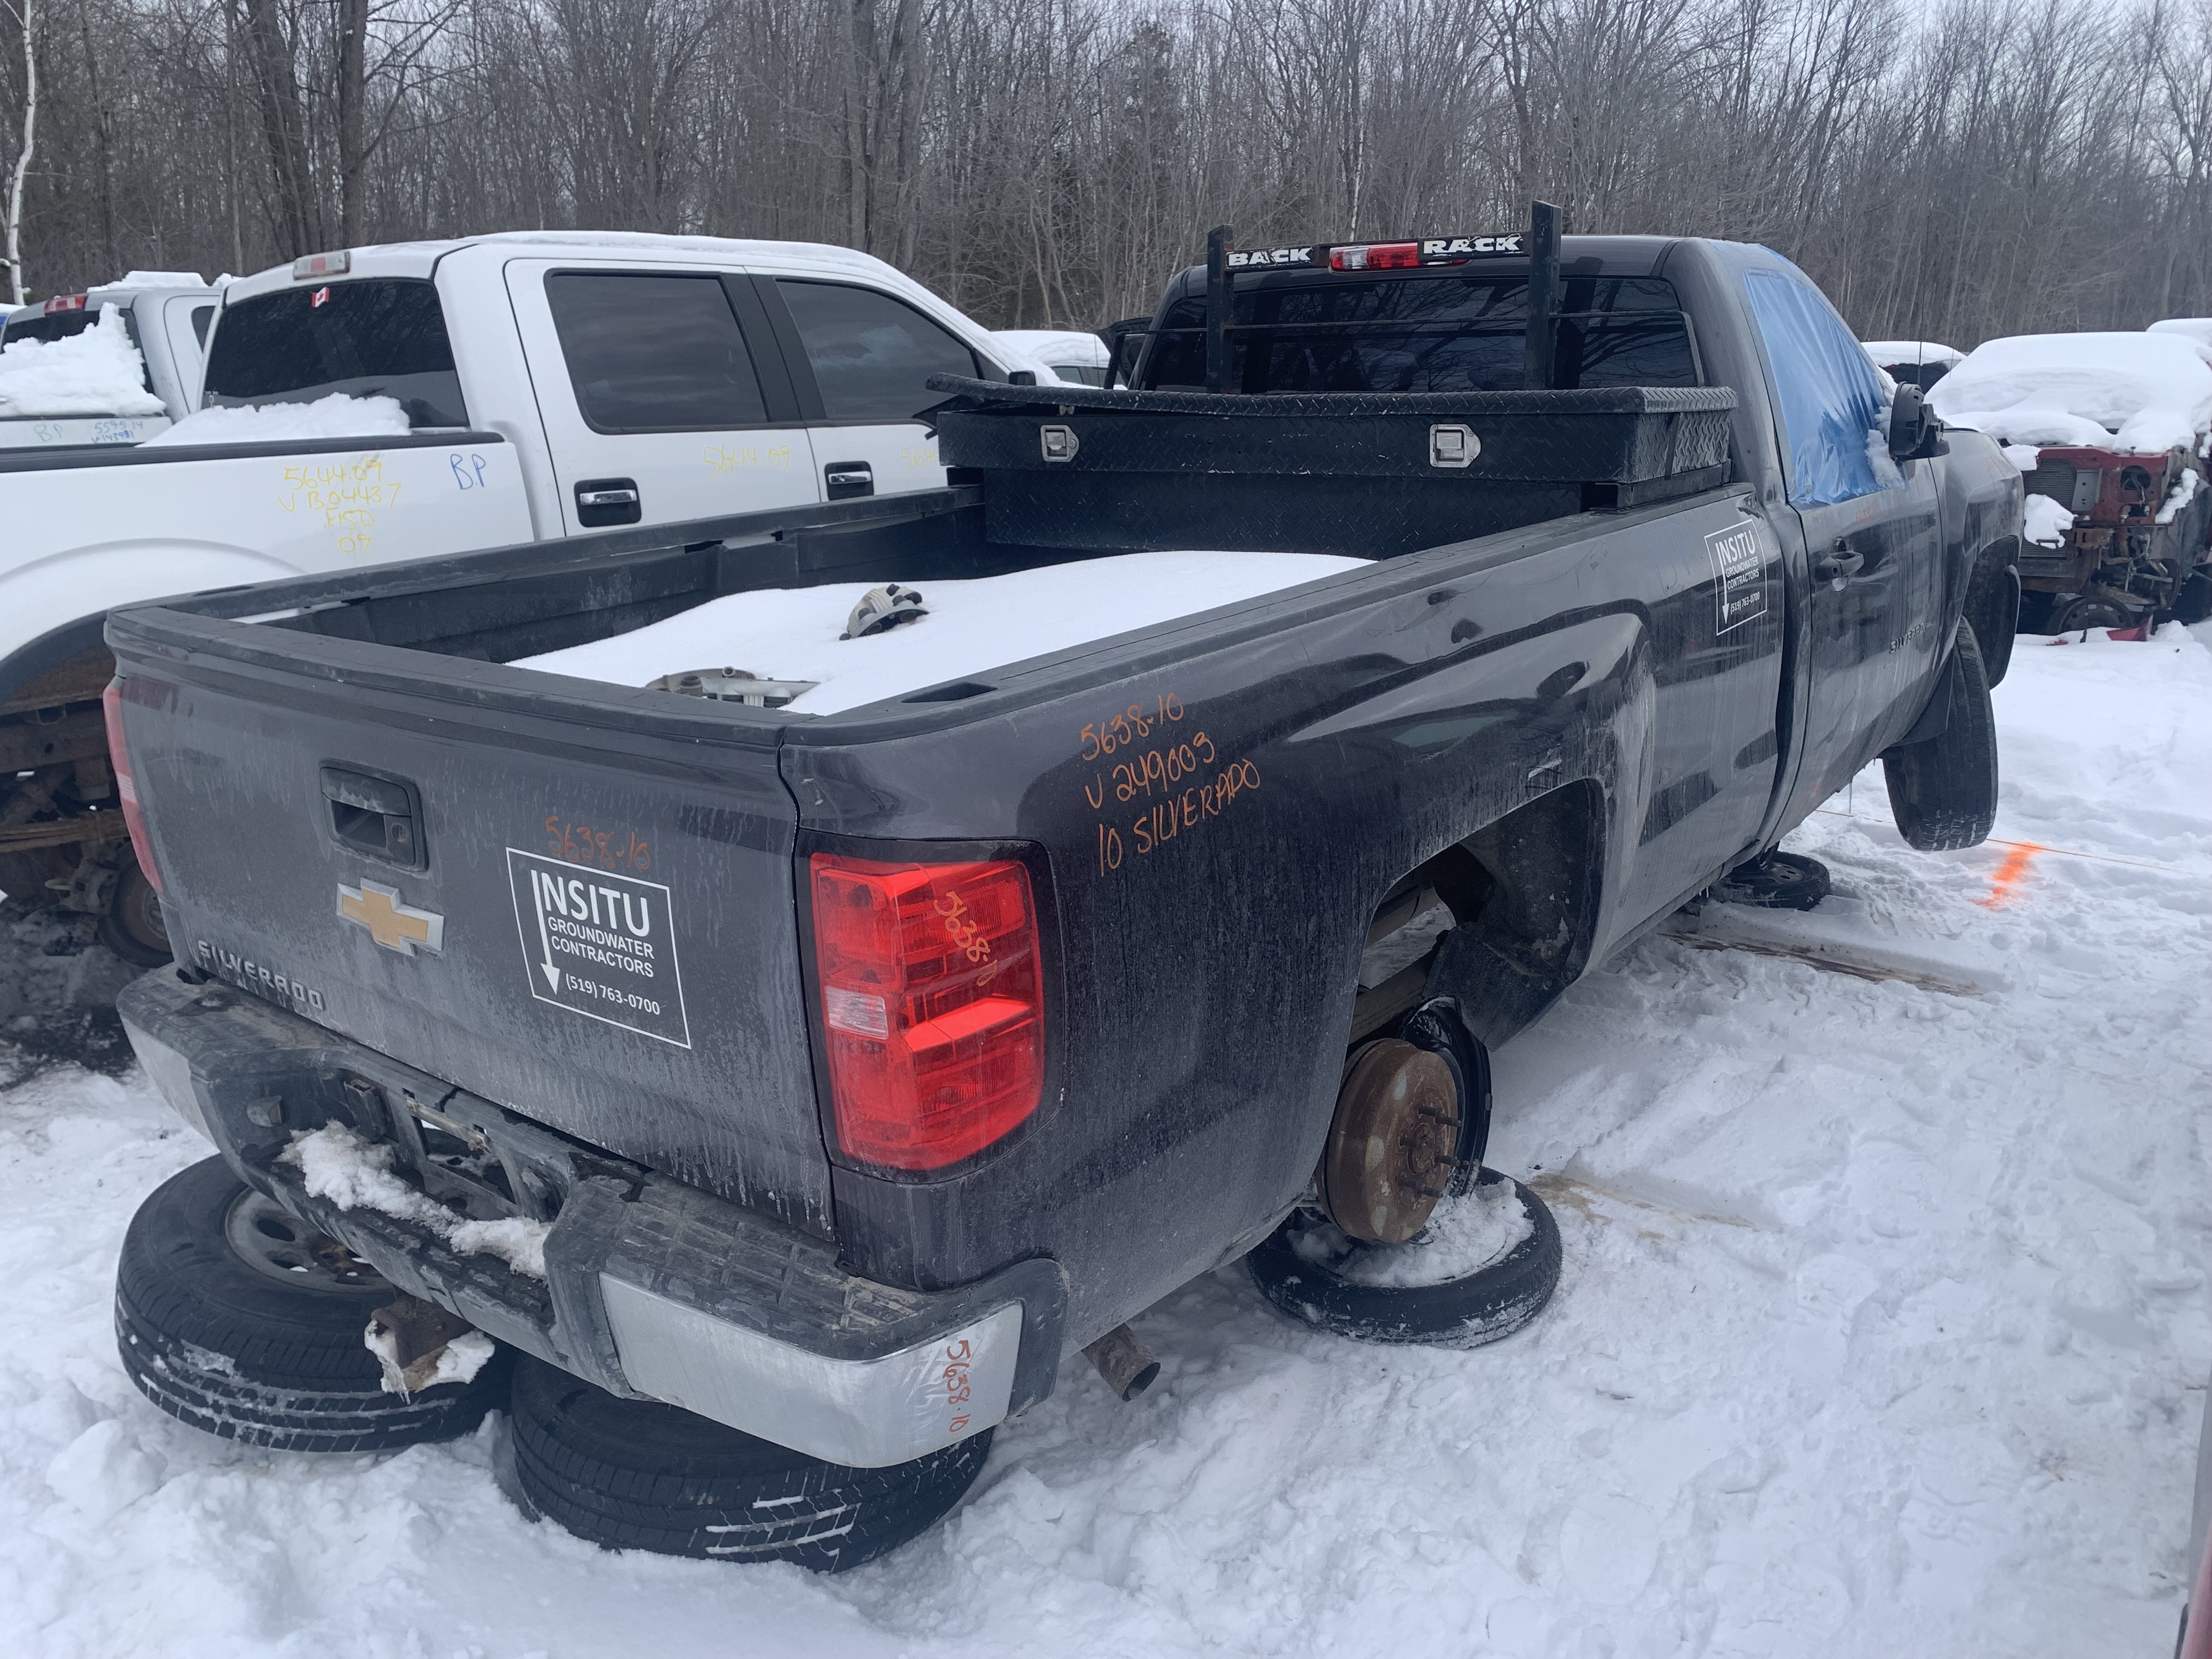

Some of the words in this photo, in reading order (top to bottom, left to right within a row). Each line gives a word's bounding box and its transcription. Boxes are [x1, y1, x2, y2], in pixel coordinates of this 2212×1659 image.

[1228, 247, 1311, 266] BACK
[1423, 236, 1521, 254] RACK
[1715, 529, 1756, 566] INSITU
[1725, 556, 1759, 578] GROUNDWATER
[1727, 568, 1759, 590] CONTRACTORS
[1730, 599, 1741, 615] (519)
[1741, 591, 1760, 607] 763-0700
[1099, 823, 1122, 878] 10
[1133, 758, 1261, 854] SILVERADO
[531, 869, 650, 937] INSITU
[548, 916, 655, 960] GROUNDWATER
[551, 935, 654, 978] CONTRACTORS
[198, 939, 325, 1011] SILVERADO
[565, 973, 597, 999] (519)
[599, 984, 661, 1015] 763-0700
